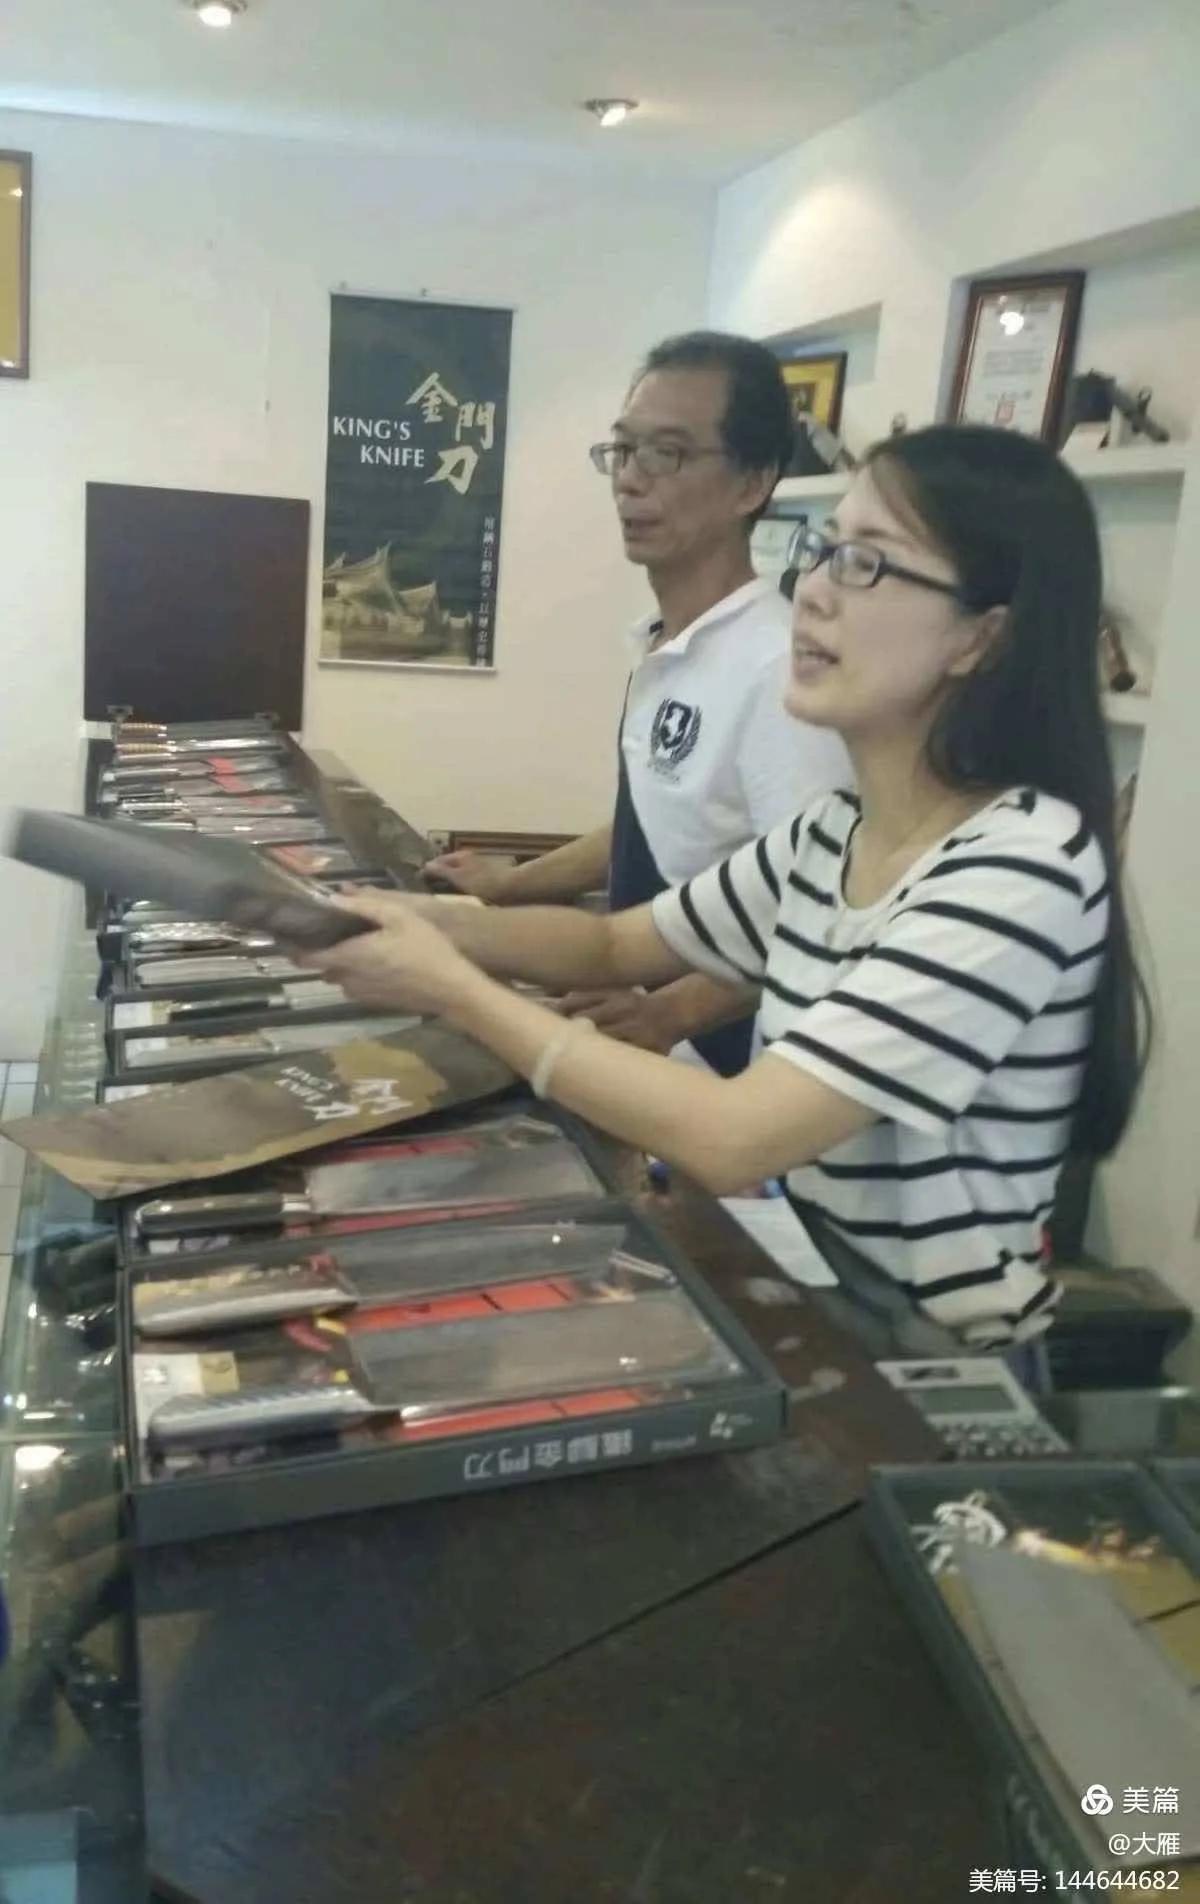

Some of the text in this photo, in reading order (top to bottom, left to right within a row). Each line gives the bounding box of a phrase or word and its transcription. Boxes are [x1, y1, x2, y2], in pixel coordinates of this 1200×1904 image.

[333, 416, 411, 441] KING'S
[405, 371, 496, 495] 金門刀
[360, 444, 425, 468] KNIFE
